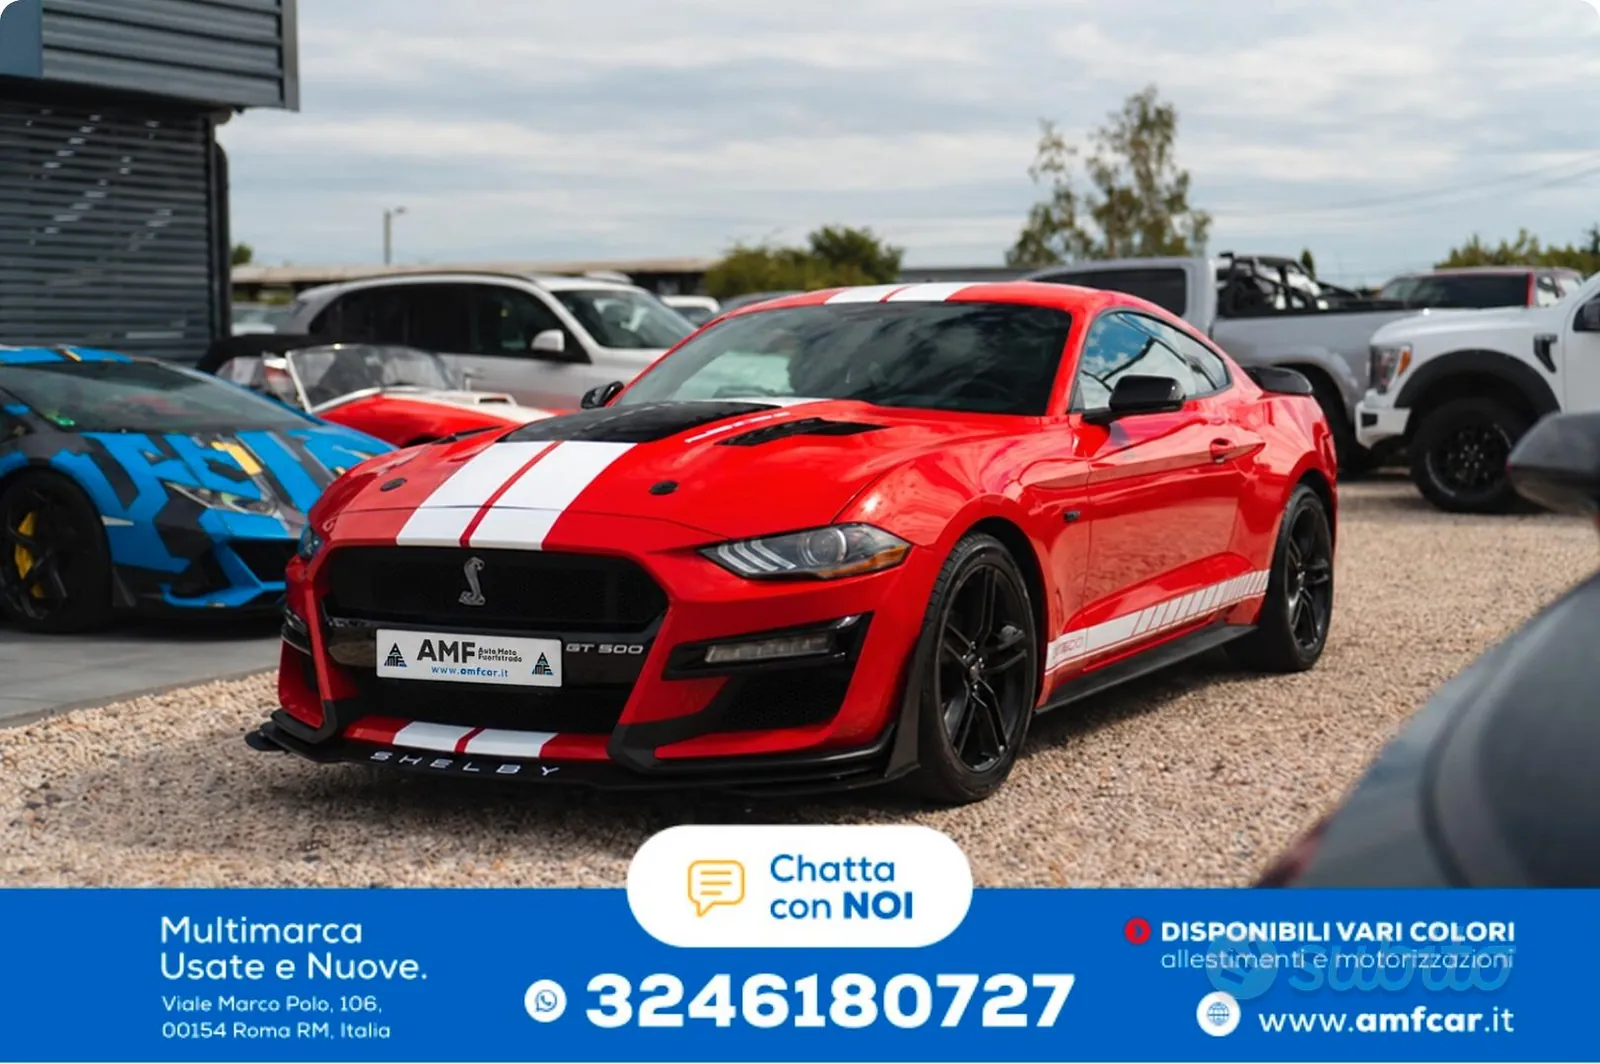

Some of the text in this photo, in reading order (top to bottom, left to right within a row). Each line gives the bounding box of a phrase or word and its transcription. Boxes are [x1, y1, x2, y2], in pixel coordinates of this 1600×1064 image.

[417, 639, 476, 663] AMF
[478, 647, 517, 656] Auto Moto
[565, 643, 644, 655] GT 500
[431, 664, 508, 677] www.amfcar.it
[370, 751, 560, 776] SHELBY
